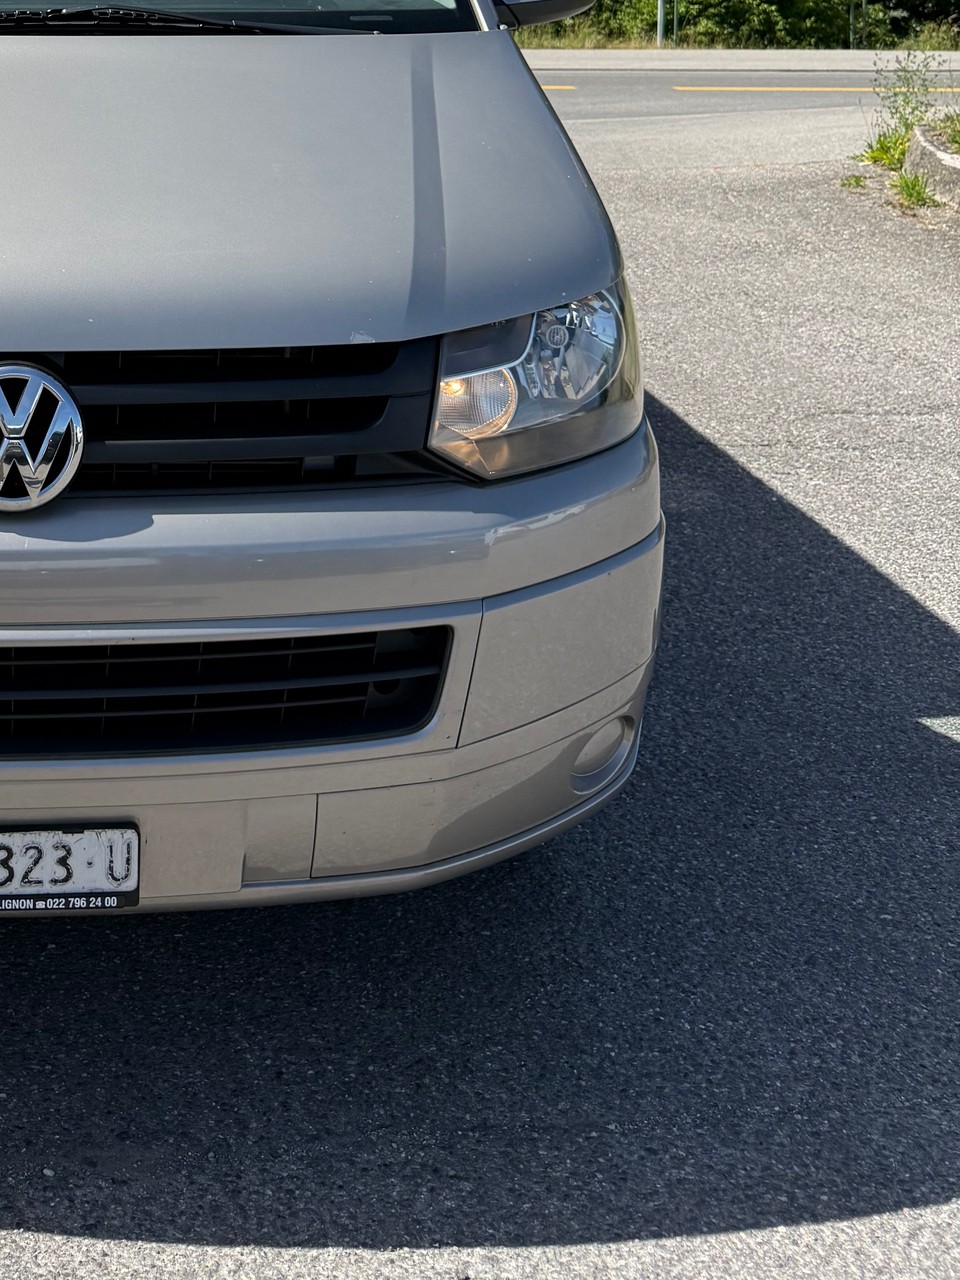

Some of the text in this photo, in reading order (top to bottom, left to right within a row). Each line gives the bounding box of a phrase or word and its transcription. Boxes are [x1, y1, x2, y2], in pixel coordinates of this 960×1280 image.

[106, 841, 132, 884] U
[46, 899, 65, 908] 022
[68, 898, 86, 908] 796
[89, 898, 102, 907] 24
[105, 897, 117, 907] 00
